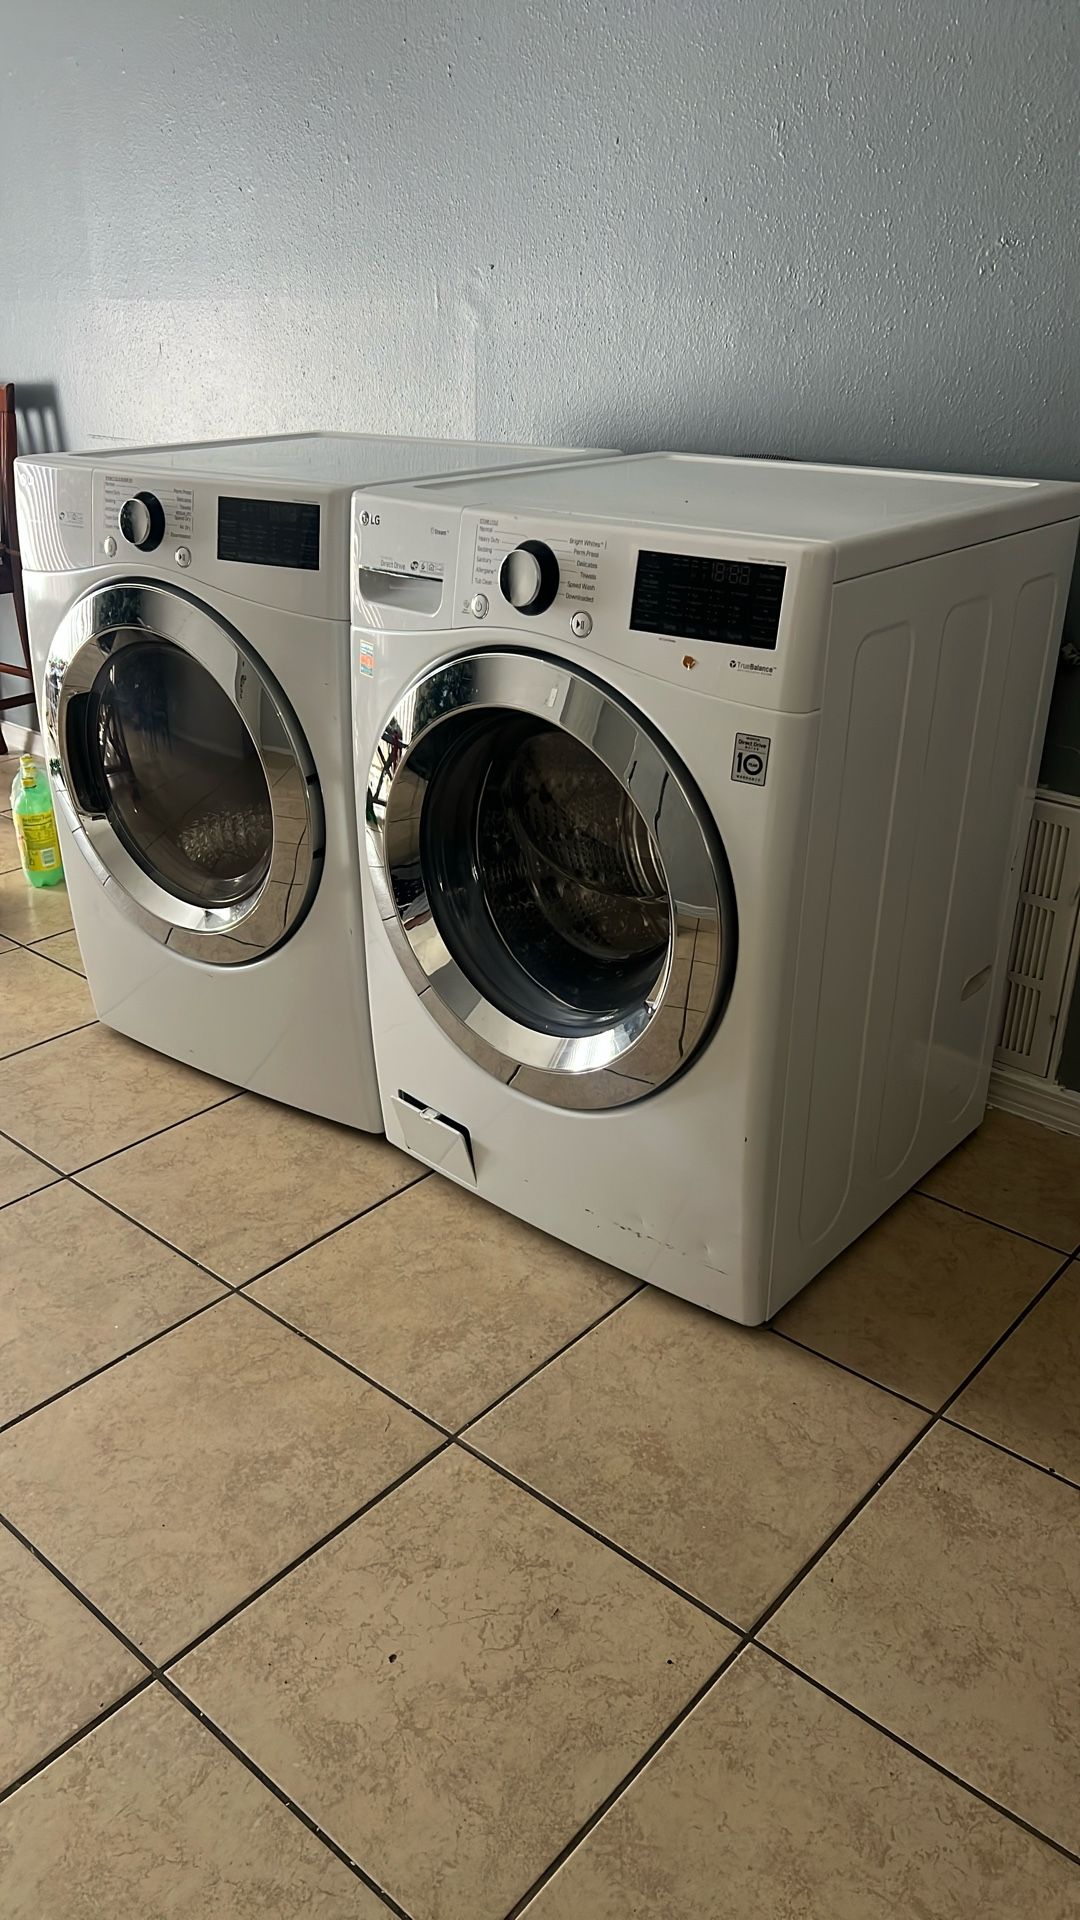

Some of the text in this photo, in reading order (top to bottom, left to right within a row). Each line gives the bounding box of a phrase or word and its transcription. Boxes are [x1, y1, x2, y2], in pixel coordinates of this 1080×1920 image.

[370, 514, 381, 526] LG
[569, 537, 583, 546] Bright
[380, 559, 405, 570] Direct Drive
[576, 560, 598, 569] Delicates
[580, 572, 597, 580] Towels
[567, 581, 596, 591] Speed Wash
[565, 592, 594, 602] Downloaded
[738, 738, 753, 747] Direct
[753, 741, 767, 749] Drive
[736, 752, 763, 775] 10
